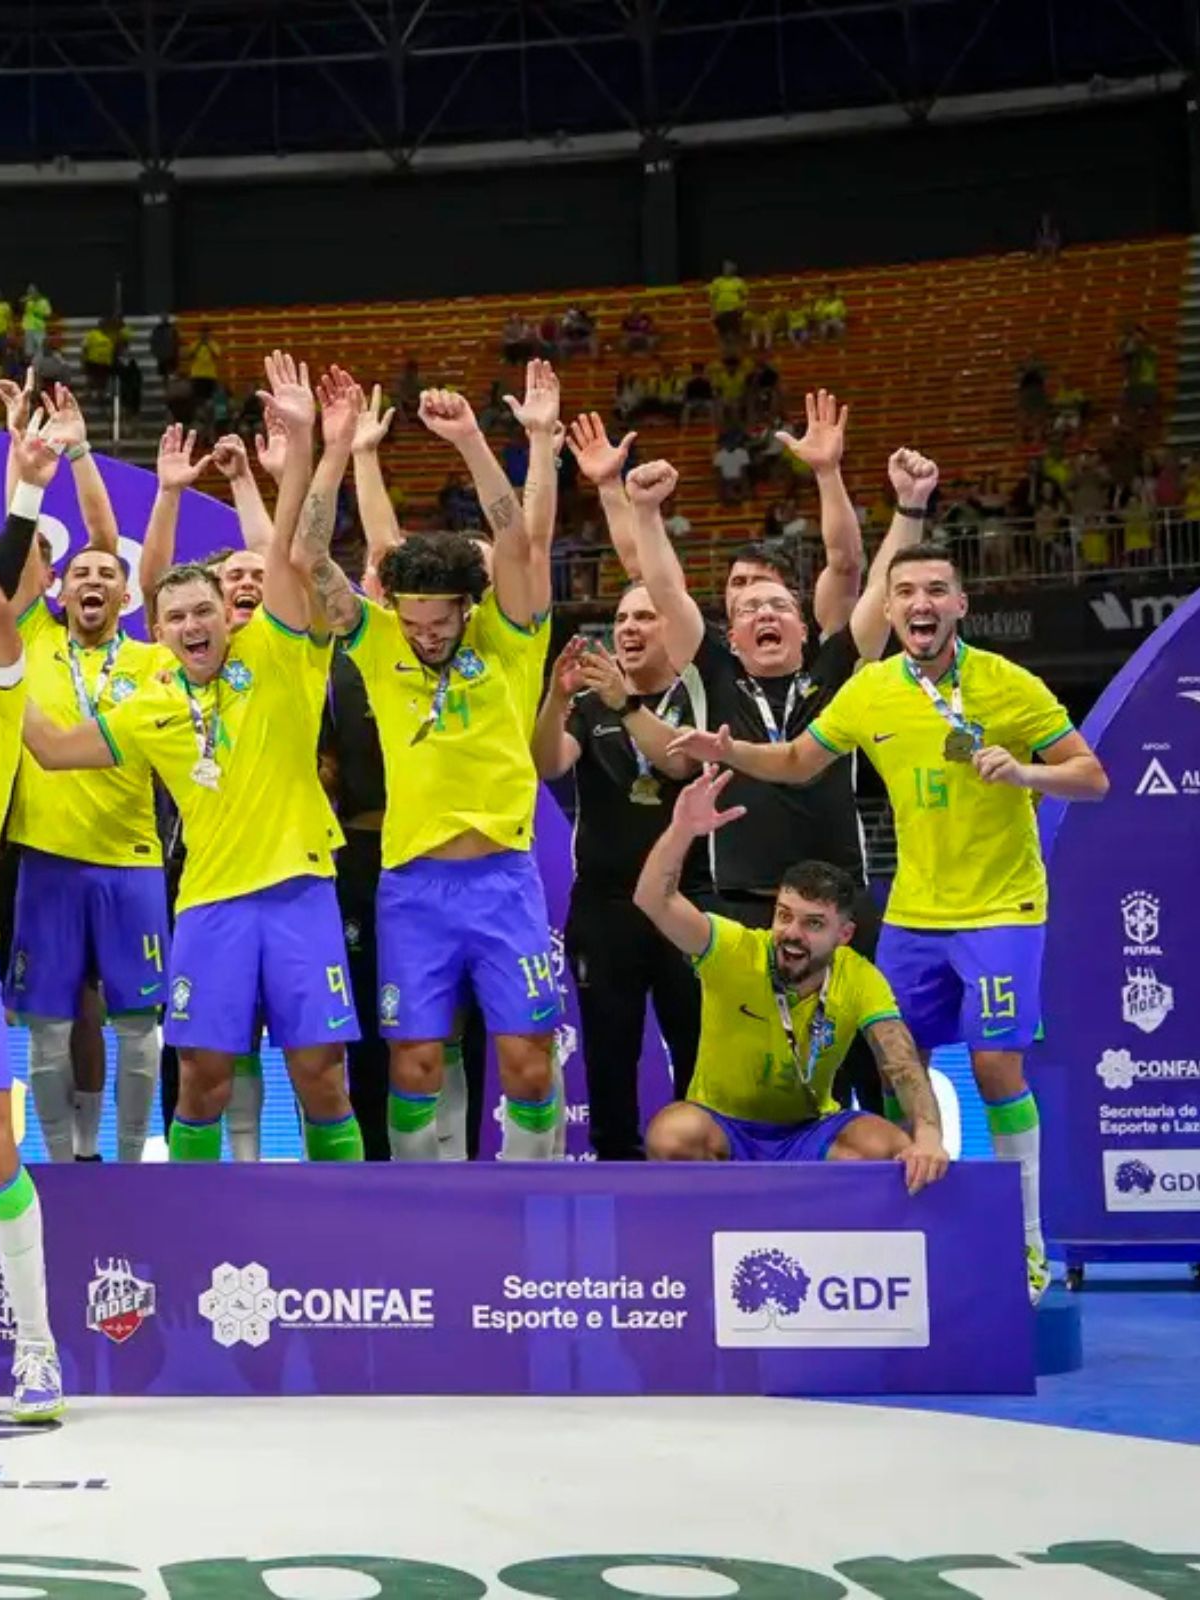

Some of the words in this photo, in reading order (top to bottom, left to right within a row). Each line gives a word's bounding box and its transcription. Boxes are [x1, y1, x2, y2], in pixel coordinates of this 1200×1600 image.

[913, 767, 949, 808] 15
[142, 934, 163, 973] 4
[1122, 945, 1163, 956] FUTSAL
[325, 964, 350, 1007] 9
[517, 951, 554, 998] 14
[978, 975, 1015, 1019] 15
[1134, 1060, 1200, 1078] CONFA
[1100, 1104, 1175, 1119] Secretaria
[1178, 1104, 1198, 1118] de
[1100, 1120, 1158, 1136] Esporte
[1161, 1121, 1171, 1133] e
[1159, 1173, 1200, 1192] GD
[502, 1275, 643, 1300] Secretaria
[651, 1275, 686, 1299] de
[816, 1275, 912, 1312] GDF
[277, 1288, 434, 1322] CONFAE
[471, 1304, 579, 1334] Esporte
[586, 1310, 603, 1329] e
[611, 1304, 688, 1330] Lazer
